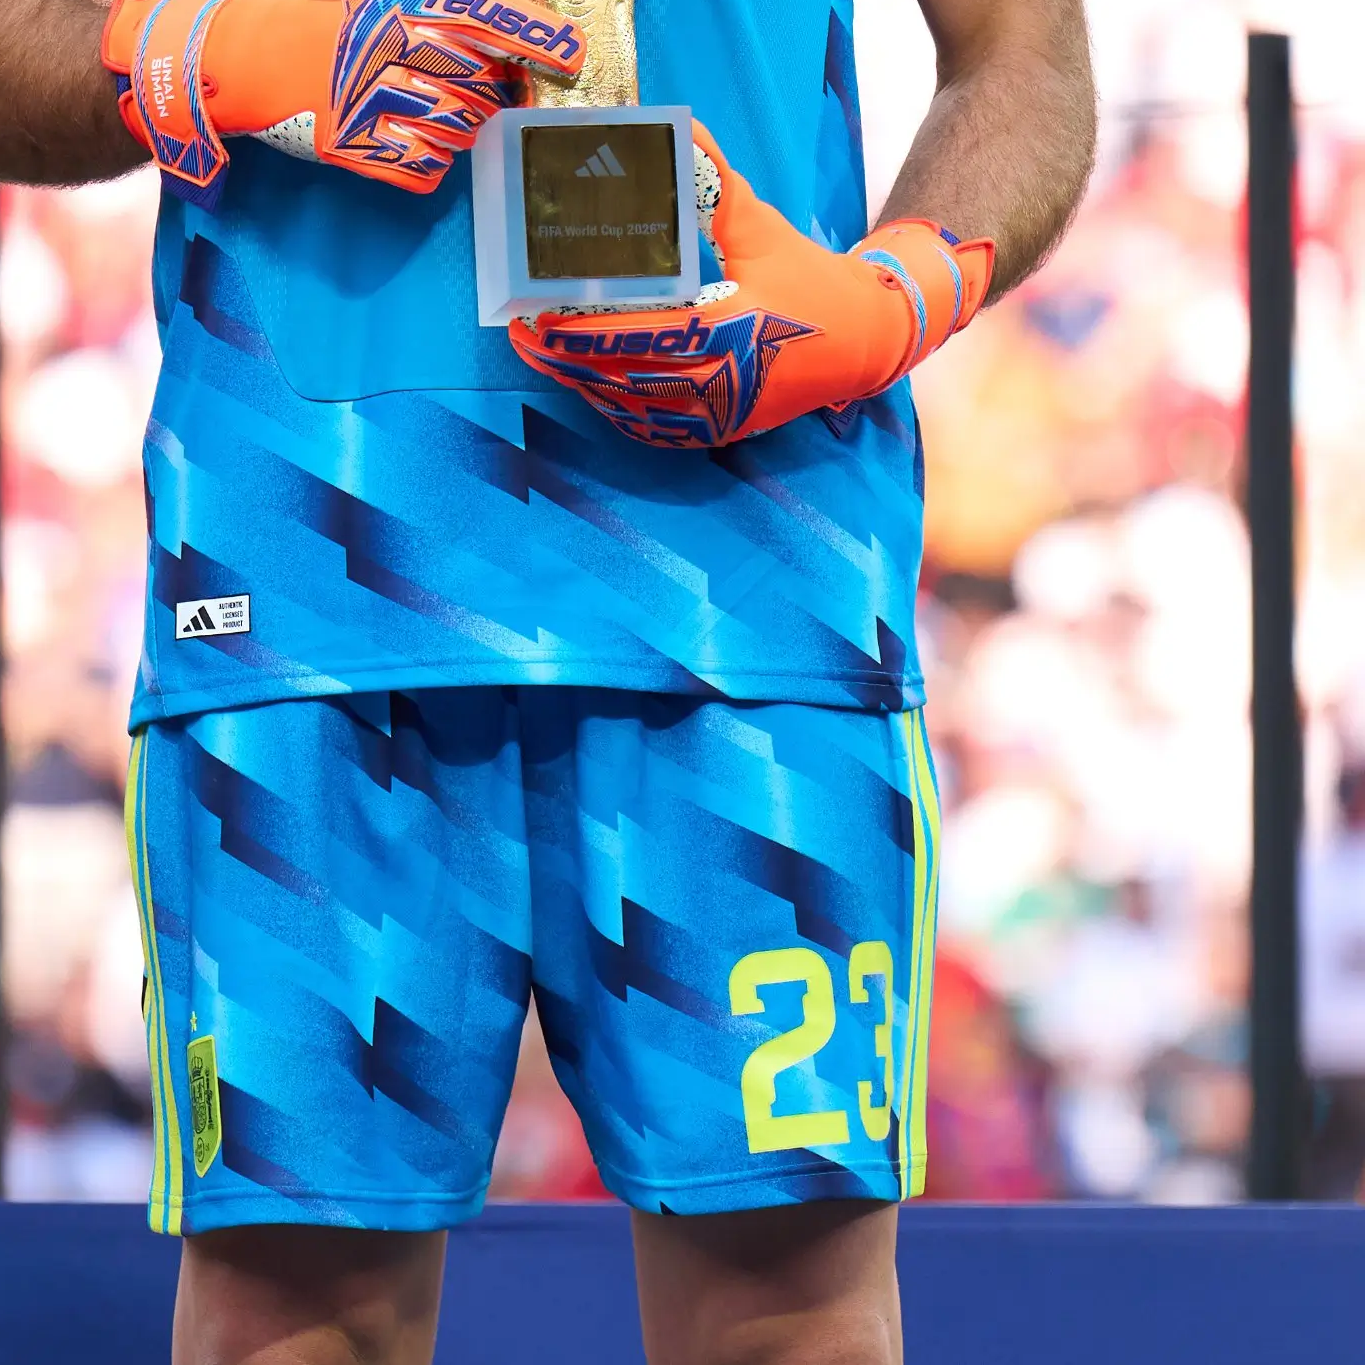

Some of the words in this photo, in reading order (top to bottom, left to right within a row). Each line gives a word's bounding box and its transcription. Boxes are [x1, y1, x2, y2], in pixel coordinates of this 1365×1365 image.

[151, 59, 170, 118] SIMON
[163, 56, 175, 100] UNAI
[538, 225, 562, 237] FIFA
[565, 225, 597, 237] World
[601, 224, 623, 237] Cup
[543, 316, 711, 354] reusch
[219, 601, 242, 609] AUTHENTIC
[223, 620, 243, 628] PRODUCT
[729, 940, 894, 1154] 23
